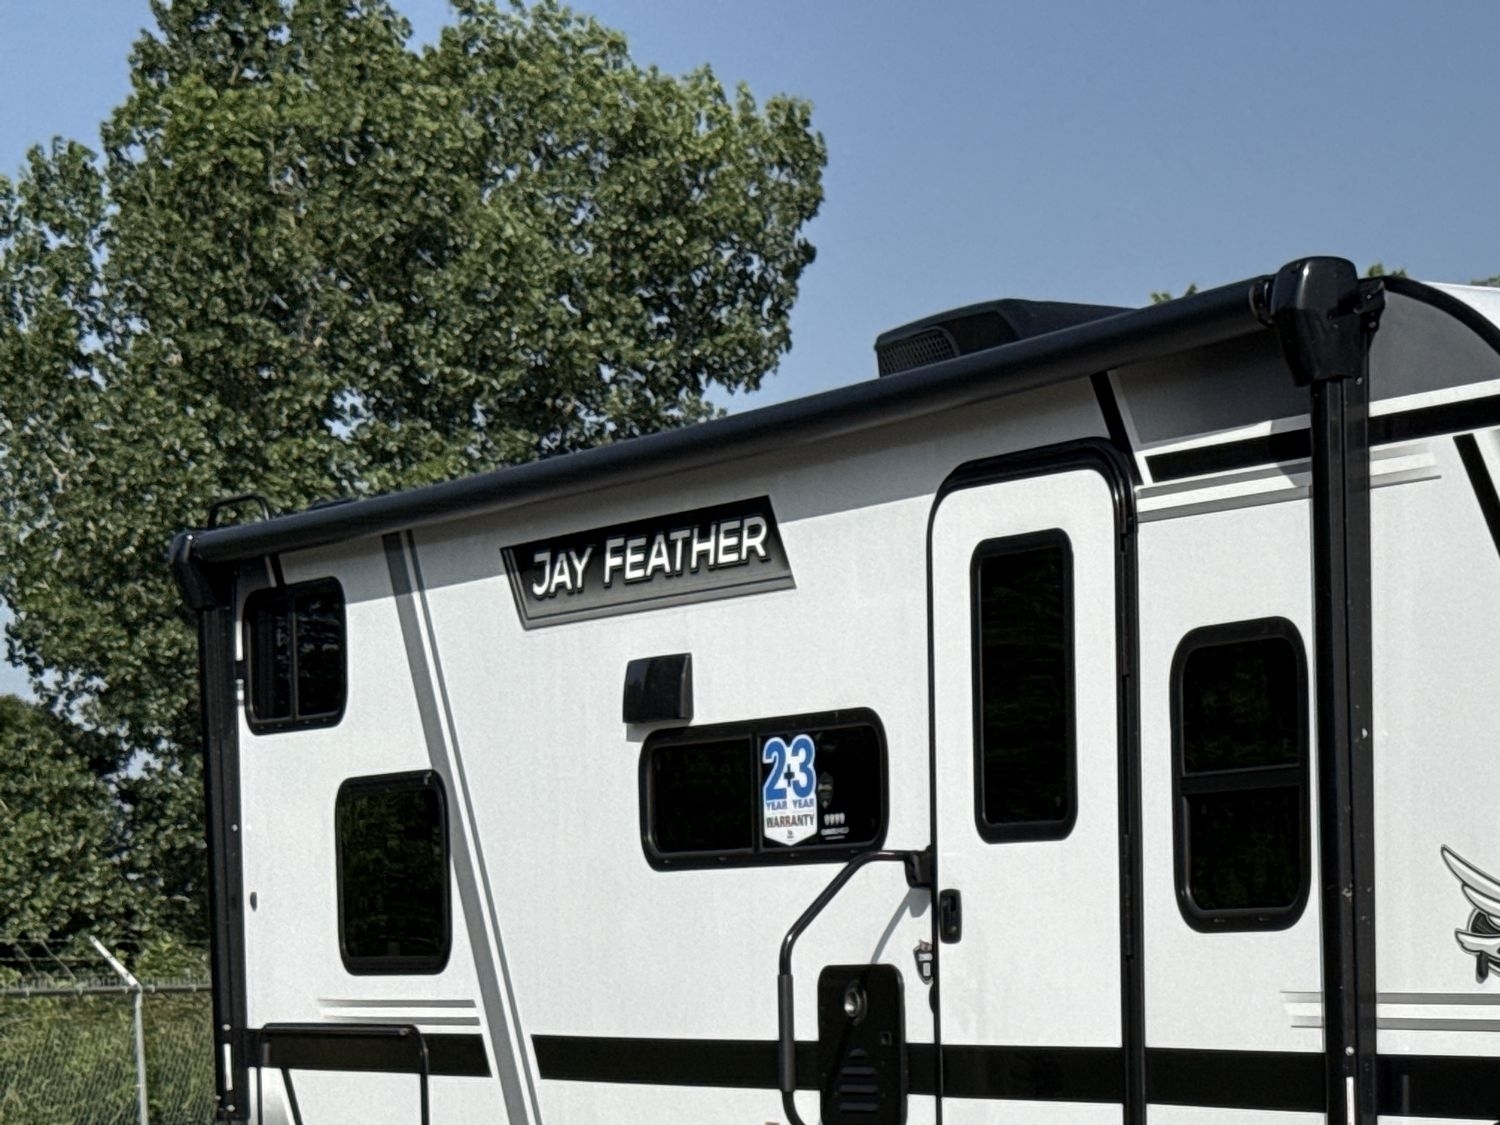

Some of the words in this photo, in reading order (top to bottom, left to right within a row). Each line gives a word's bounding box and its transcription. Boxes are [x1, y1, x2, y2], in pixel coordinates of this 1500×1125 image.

[532, 547, 593, 596] JAY
[603, 515, 767, 584] FEATHER
[766, 800, 787, 811] YEAR
[792, 798, 815, 809] YEAR
[766, 814, 815, 828] WARRANTY
